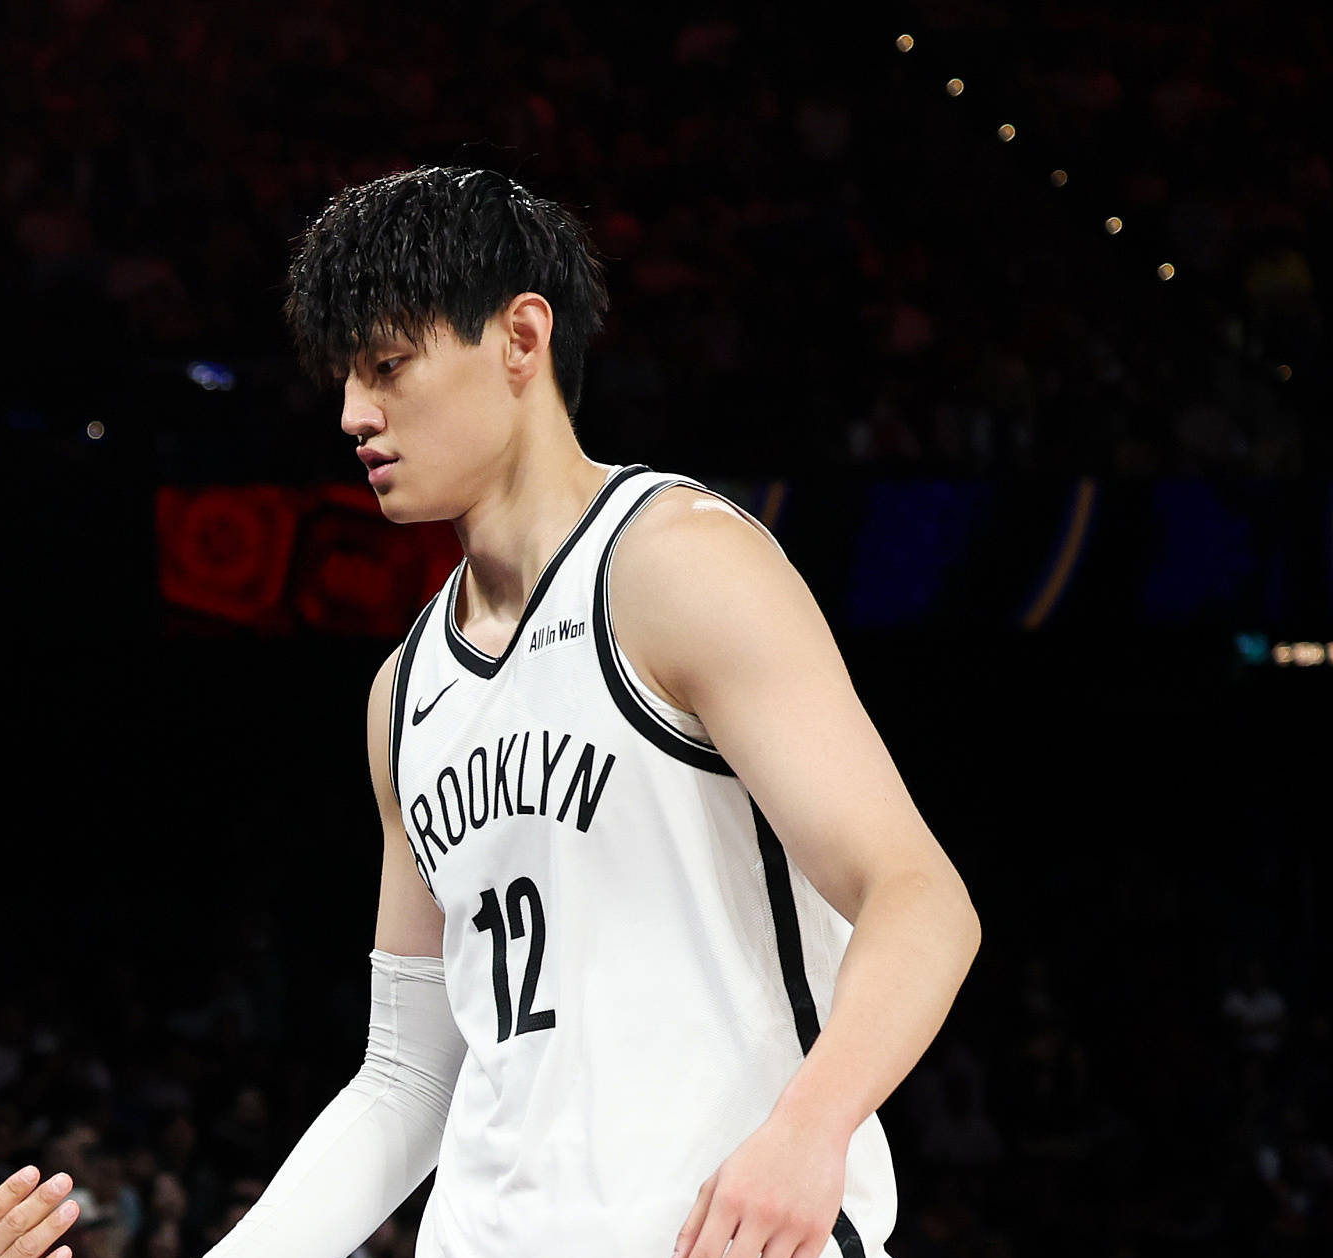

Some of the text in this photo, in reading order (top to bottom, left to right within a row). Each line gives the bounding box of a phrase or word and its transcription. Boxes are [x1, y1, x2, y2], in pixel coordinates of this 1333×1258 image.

[529, 627, 545, 653] All
[559, 618, 585, 641] Won
[471, 876, 556, 1043] 12
